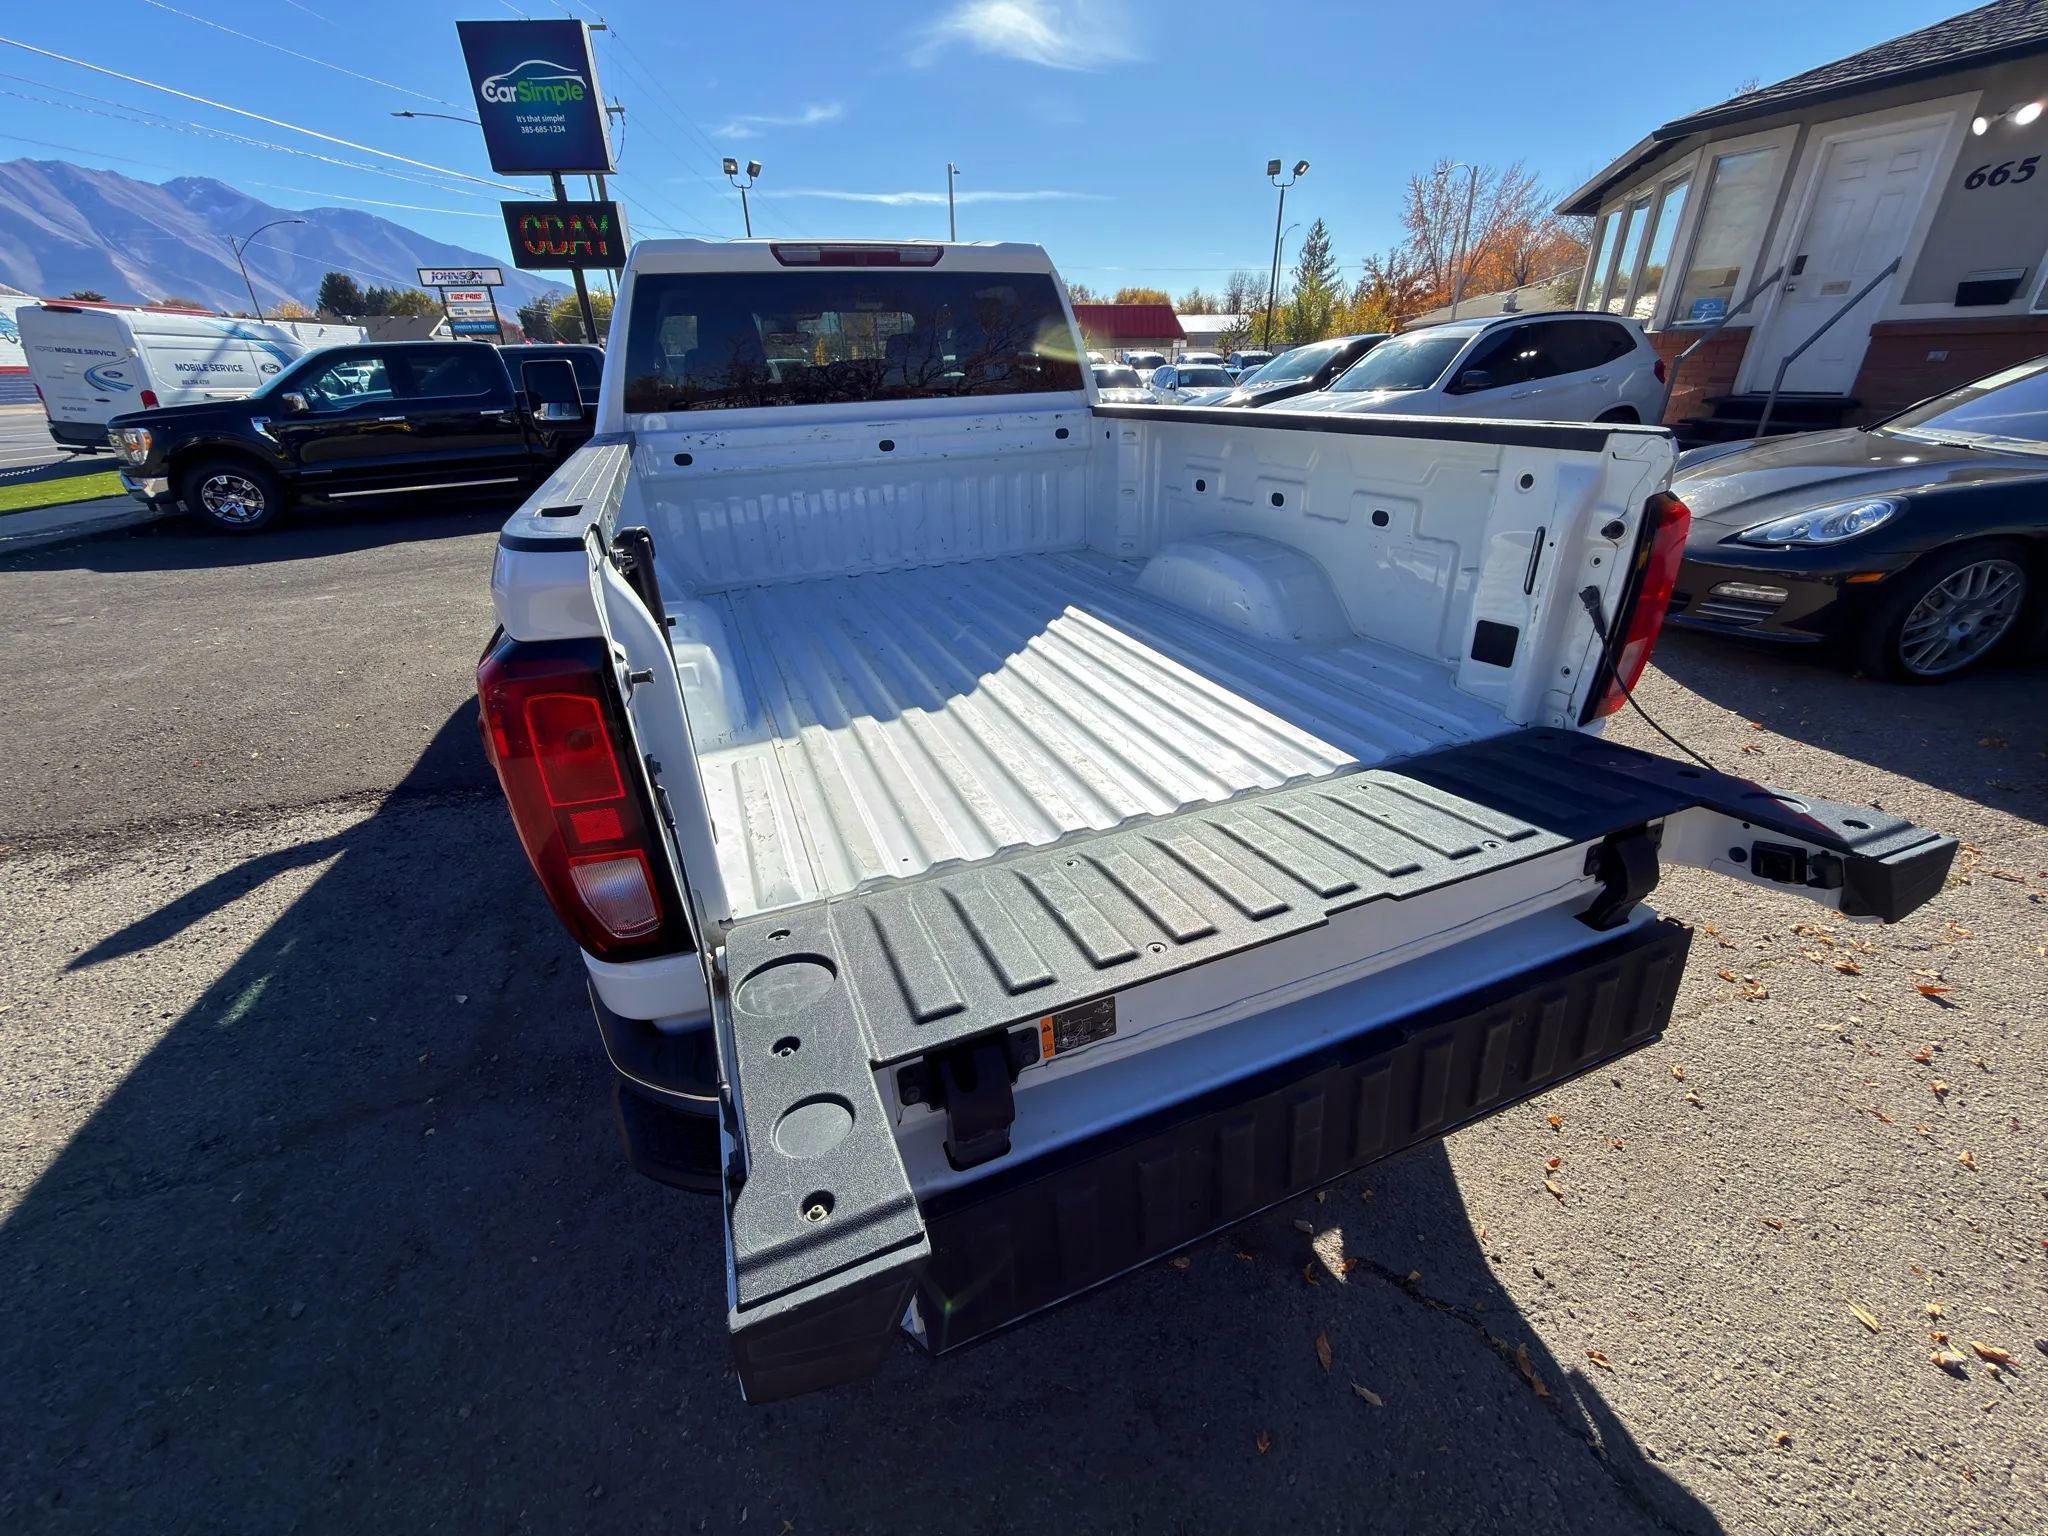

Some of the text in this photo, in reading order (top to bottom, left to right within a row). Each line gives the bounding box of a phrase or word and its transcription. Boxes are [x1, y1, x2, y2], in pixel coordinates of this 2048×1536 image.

[481, 80, 584, 106] CarSimple
[516, 114, 566, 123] It's that simple!
[521, 126, 566, 134] 385-685-1234
[1964, 154, 2042, 190] 665
[54, 346, 82, 354] MOBILE
[83, 349, 117, 357] SERVICE
[175, 363, 244, 372] MOBILE SERVICE
